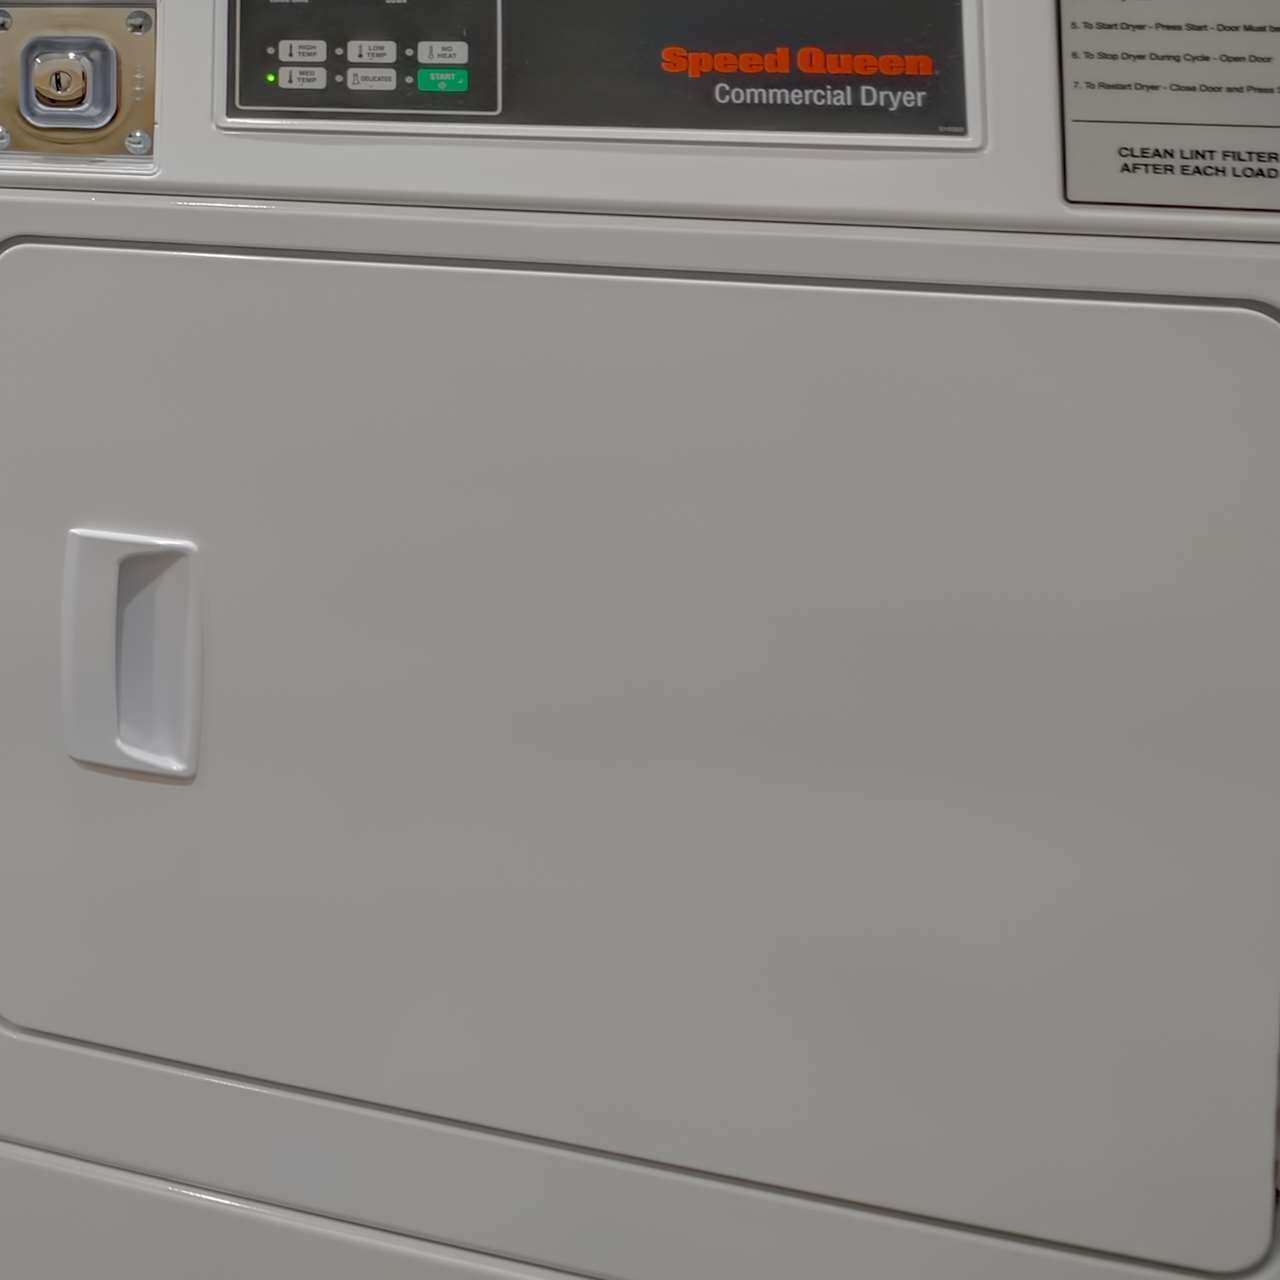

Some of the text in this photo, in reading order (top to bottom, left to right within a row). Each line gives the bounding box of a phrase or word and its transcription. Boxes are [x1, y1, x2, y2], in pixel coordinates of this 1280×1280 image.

[1096, 22, 1118, 30] Start
[1120, 23, 1147, 32] Dryer
[1155, 23, 1183, 31] Press
[1217, 24, 1240, 32] Door
[661, 47, 933, 77] Speed Queen
[1097, 52, 1118, 61] Stop
[1121, 52, 1146, 61] Dryer
[1149, 53, 1180, 62] During
[1183, 54, 1210, 63] Cycle
[1219, 55, 1246, 63] Open
[1249, 55, 1272, 63] Door
[1098, 82, 1132, 90] Restart
[1134, 83, 1160, 92] Dryer
[1169, 84, 1197, 92] Close
[1200, 85, 1223, 93] Door
[714, 83, 926, 111] Commercial Dryer
[1118, 147, 1279, 162] CLEAN LINT FILTER
[1120, 163, 1279, 179] AFTER EACH LOAD
